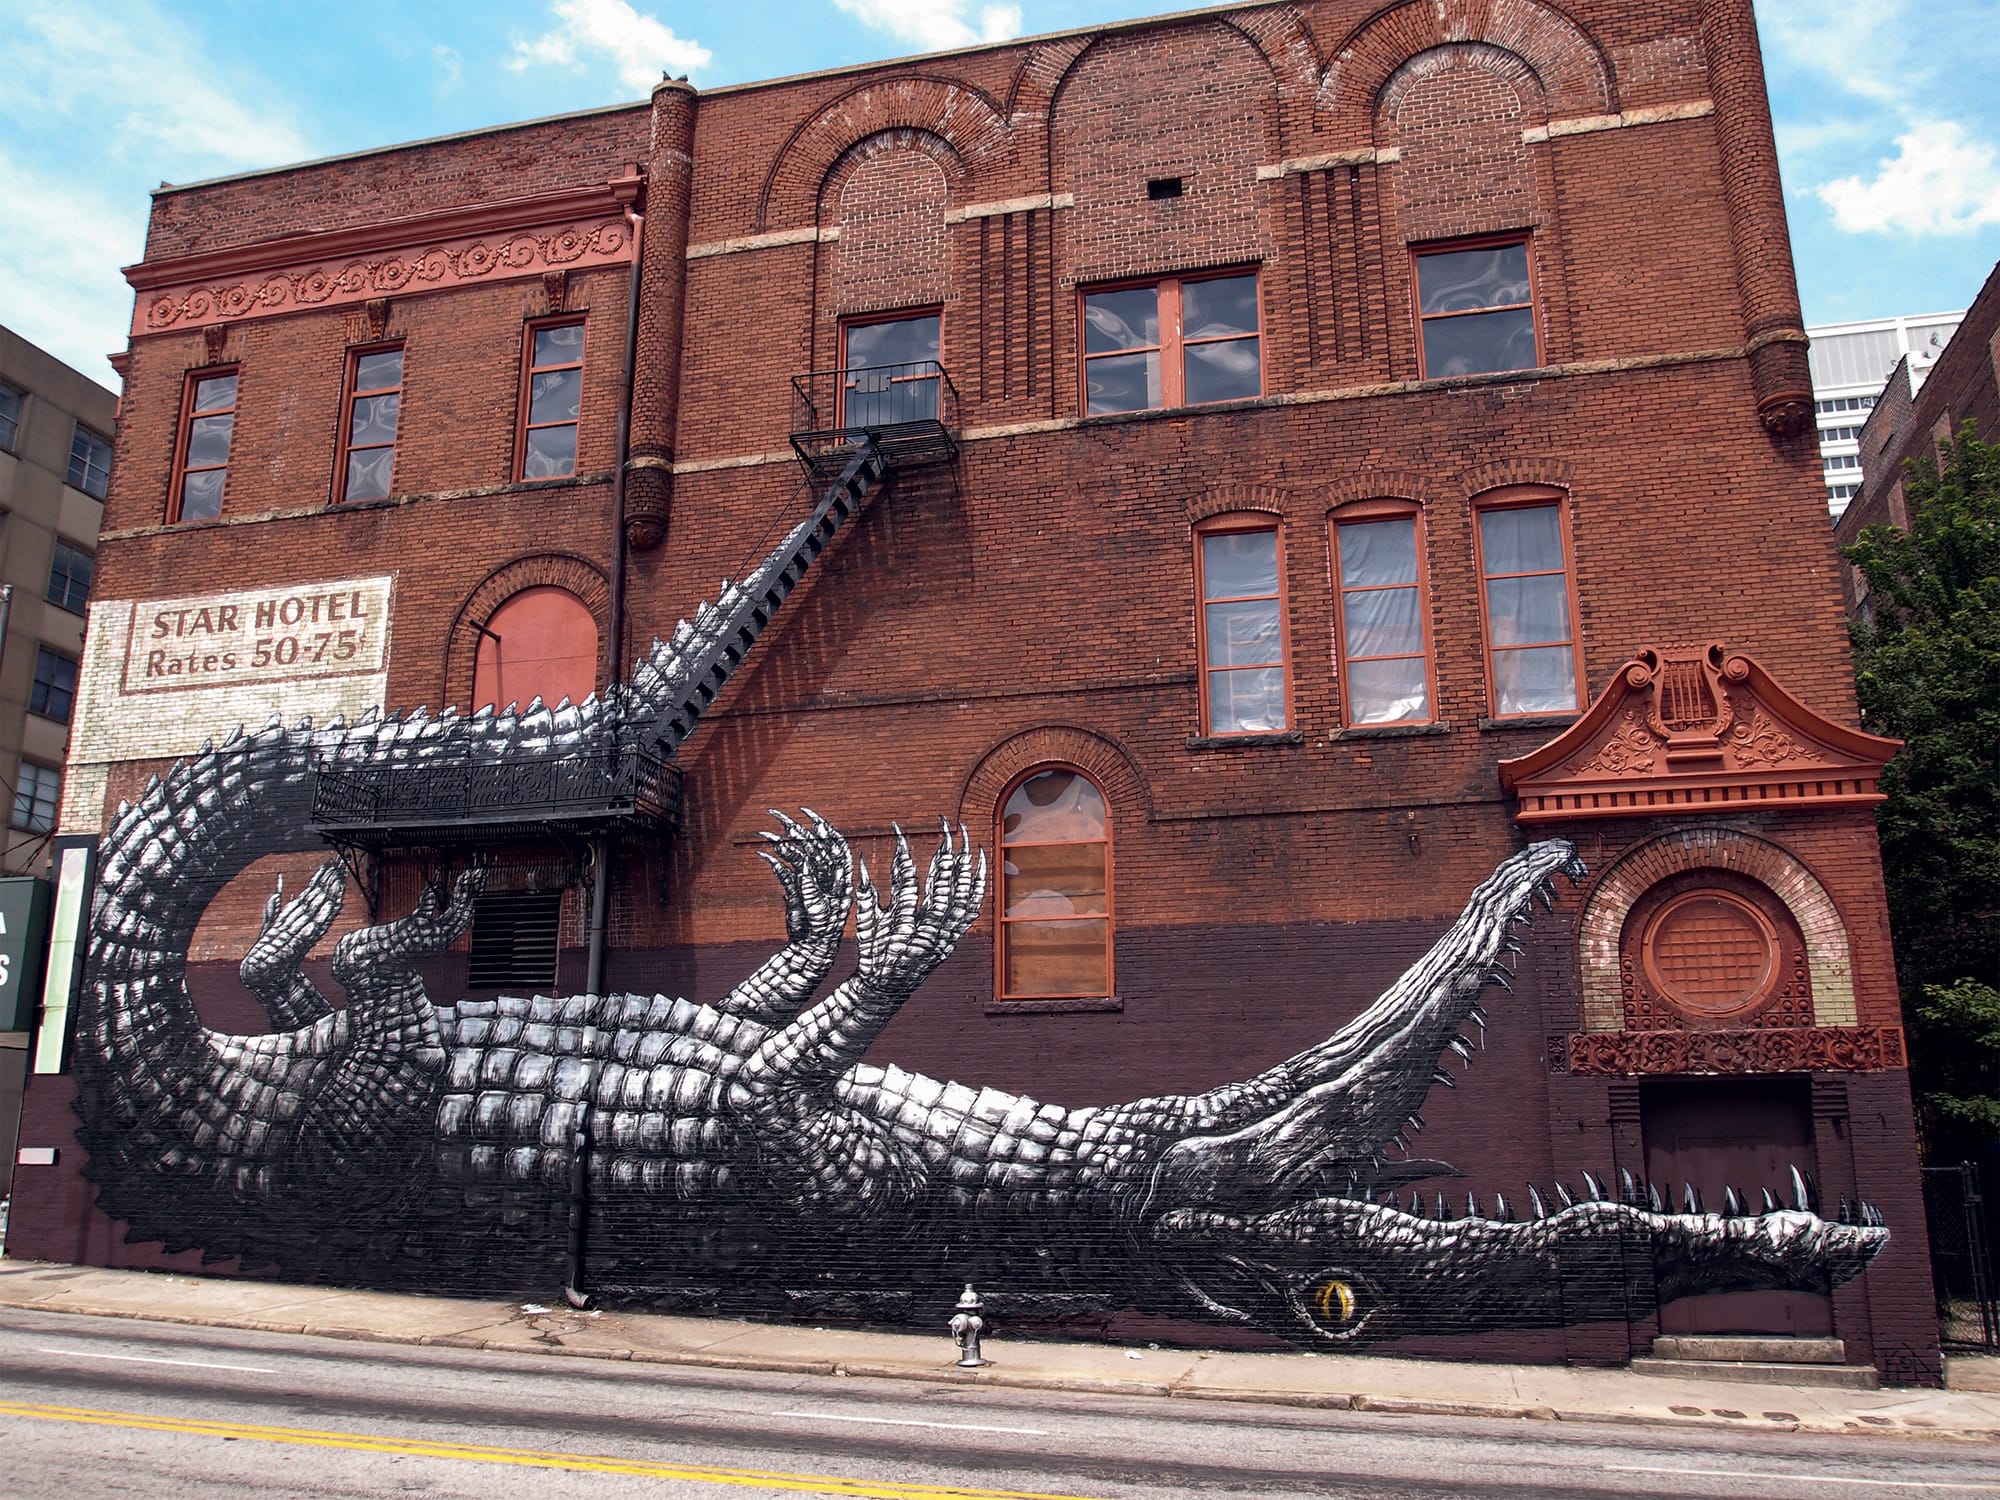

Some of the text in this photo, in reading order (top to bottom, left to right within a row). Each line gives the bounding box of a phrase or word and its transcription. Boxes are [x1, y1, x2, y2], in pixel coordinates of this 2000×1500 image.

[151, 591, 368, 639] STAR HOTEL
[146, 649, 237, 677] Rates
